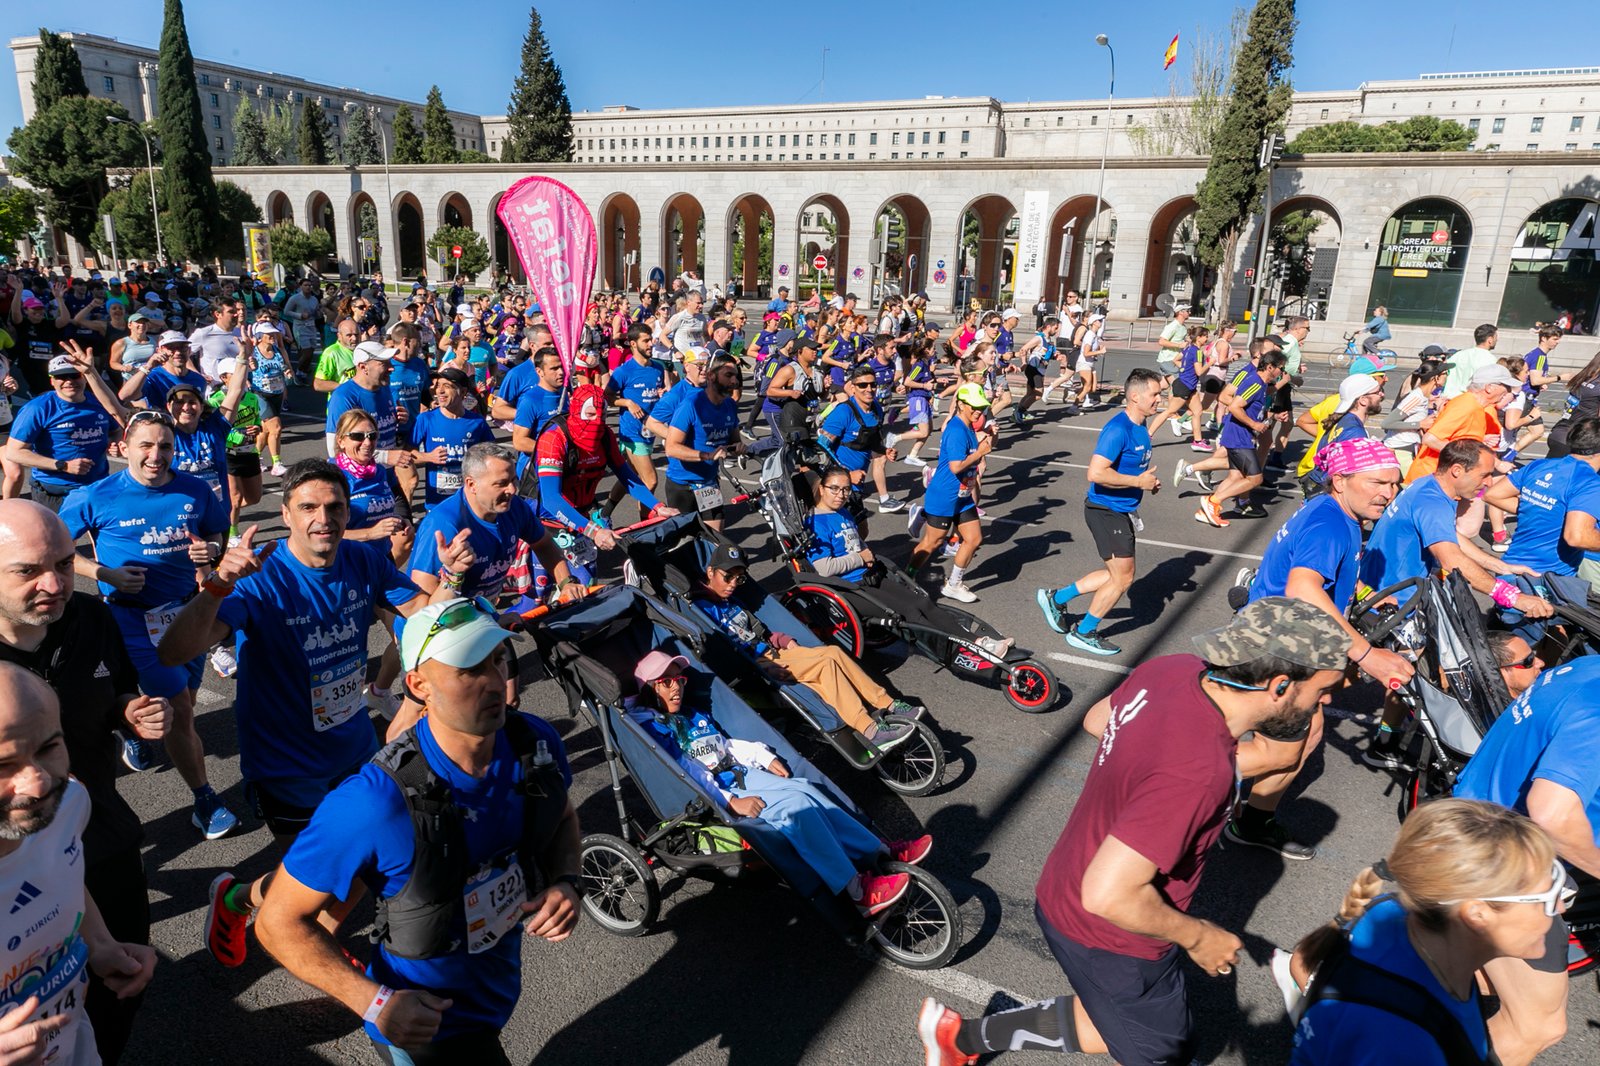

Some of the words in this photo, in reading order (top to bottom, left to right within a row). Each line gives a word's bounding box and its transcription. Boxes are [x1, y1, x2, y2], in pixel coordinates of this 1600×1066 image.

[1030, 212, 1040, 268] ARQUITECTURA
[1386, 246, 1456, 254] ARCHITECTURE,
[1400, 260, 1443, 268] ENTRANCE
[119, 518, 146, 527] aefat
[332, 679, 357, 701] 3356
[871, 892, 881, 904] N
[25, 906, 59, 938] ZURICH
